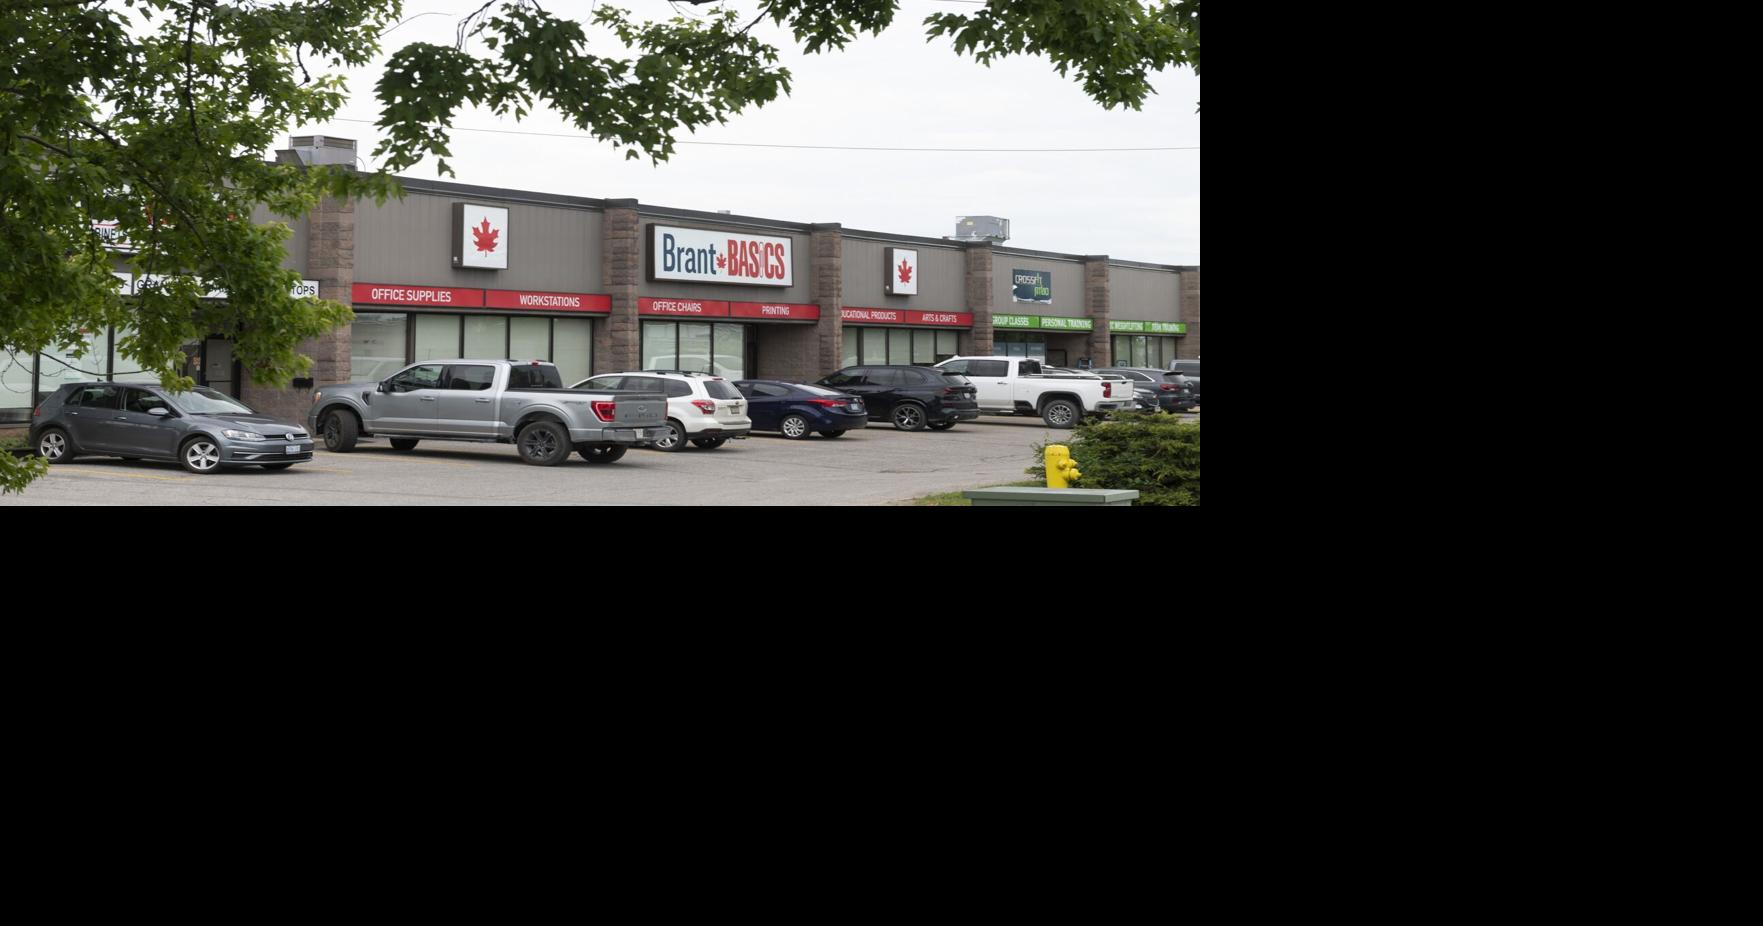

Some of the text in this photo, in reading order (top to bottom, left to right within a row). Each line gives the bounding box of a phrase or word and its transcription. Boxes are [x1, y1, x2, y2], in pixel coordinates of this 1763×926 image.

[663, 233, 785, 280] Brant BASICS
[371, 288, 451, 302] OFFICE SUPPLIES
[519, 294, 580, 307] WORKSTATIONS
[652, 301, 702, 313] OFFICE CHAIRS
[762, 306, 790, 316] PRINTING
[841, 310, 897, 320] DUCATIONAL PRODUCTS
[922, 313, 934, 322] ARTS
[940, 314, 957, 323] CRAFTS
[1008, 316, 1029, 326] CLASSES
[1041, 318, 1092, 329] PERSONAL TRAINING
